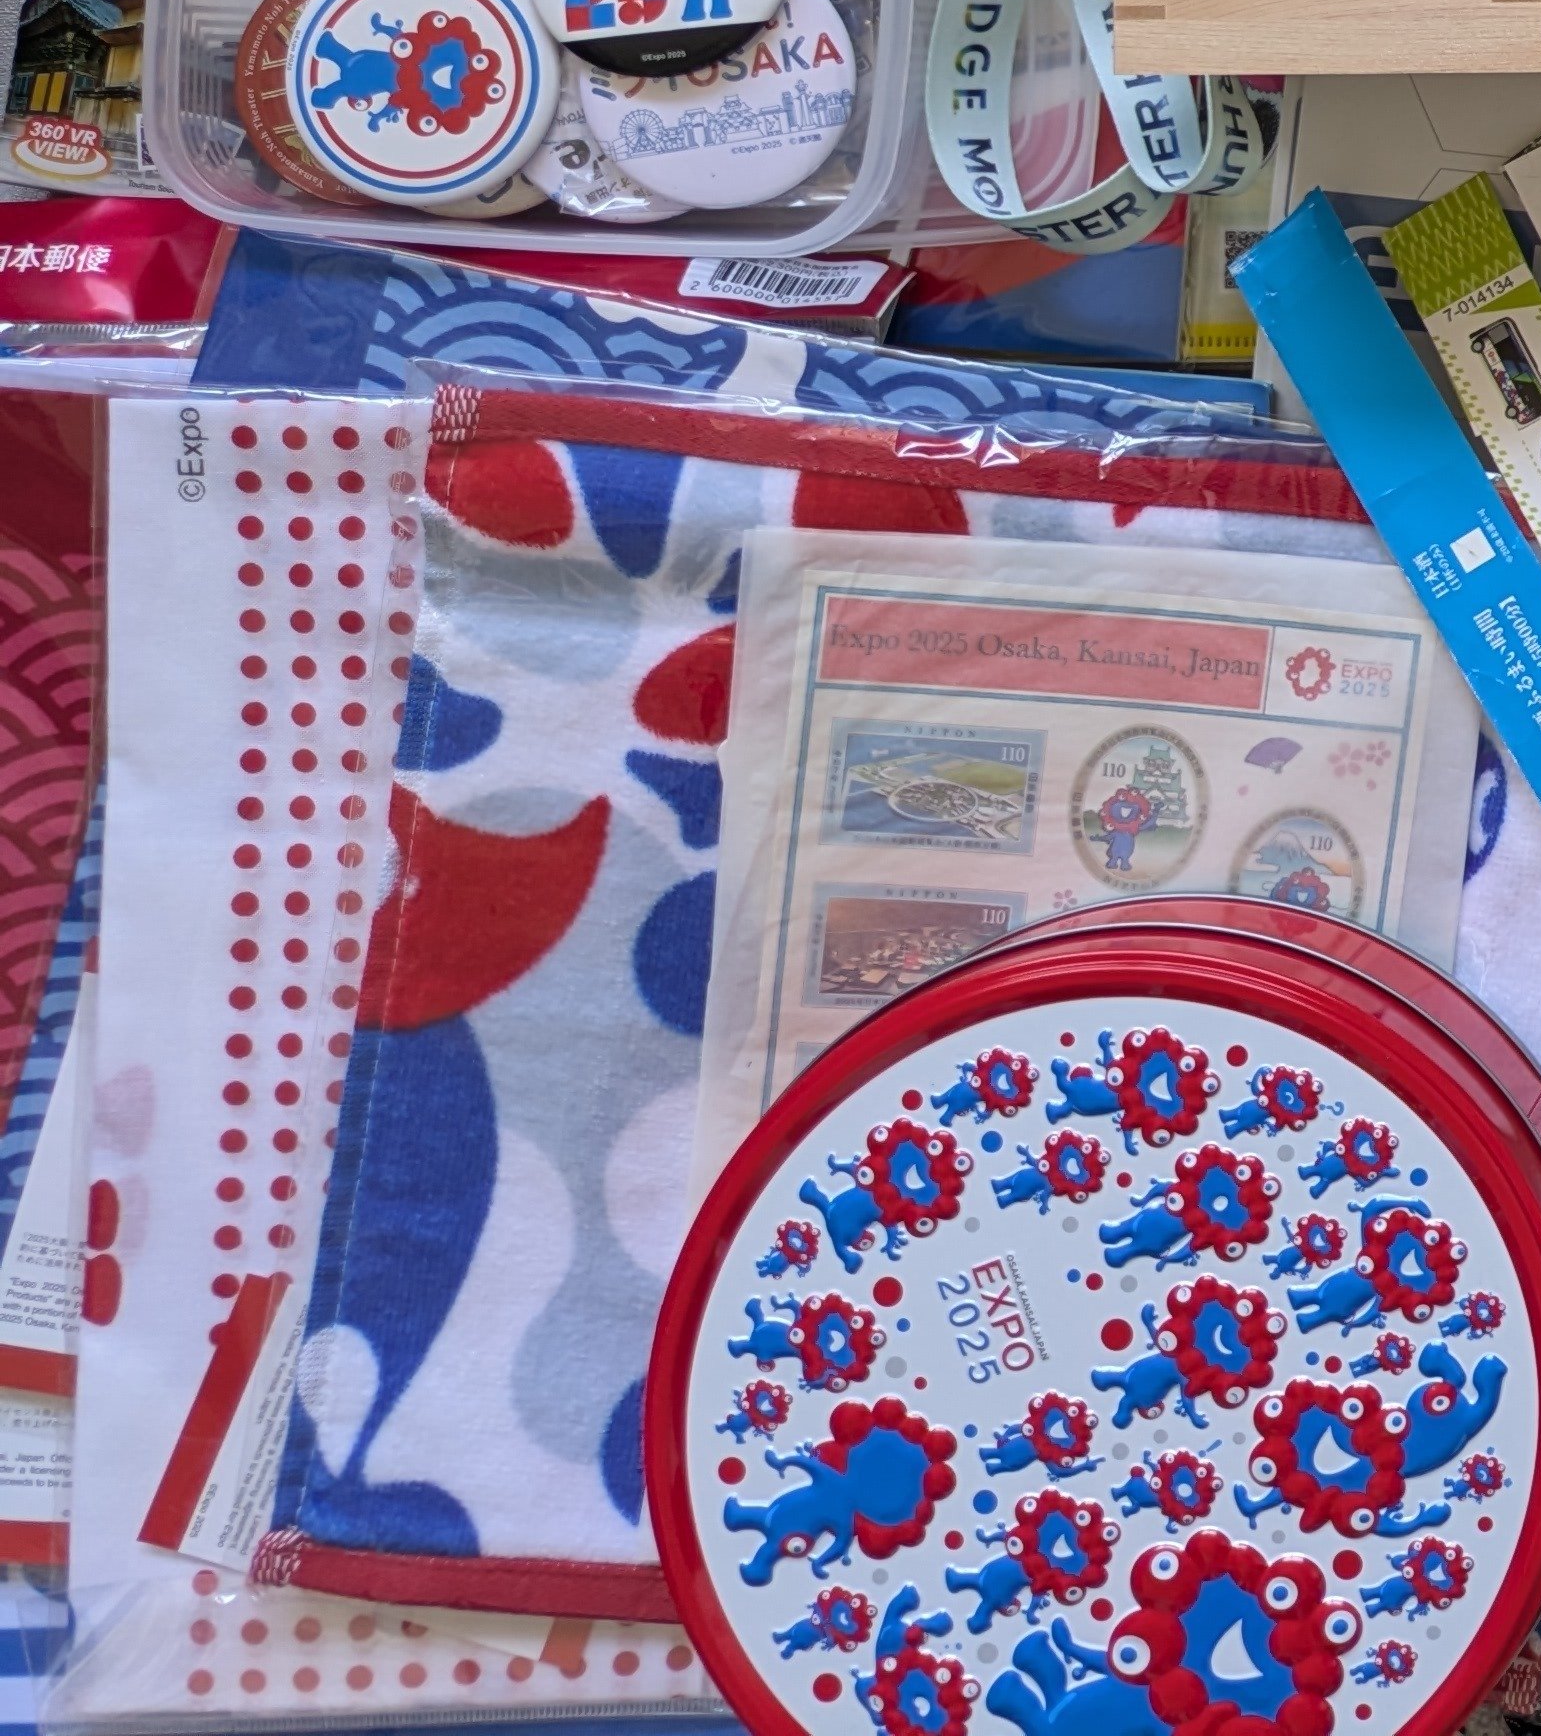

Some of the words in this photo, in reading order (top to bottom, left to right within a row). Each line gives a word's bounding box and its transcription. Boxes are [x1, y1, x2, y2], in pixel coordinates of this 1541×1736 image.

[33, 138, 91, 163] VIEW!
[1442, 275, 1515, 324] 7-014134
[177, 406, 206, 503] ©Expo
[828, 623, 899, 654] Expo
[906, 629, 969, 656] 2025
[976, 635, 1070, 665] Osaka,
[1075, 642, 1176, 675] Kansai,
[1180, 648, 1261, 681] Japan
[1339, 680, 1392, 699] 2025
[1341, 663, 1394, 682] EXPO
[999, 745, 1026, 763] 110
[1308, 834, 1335, 852] 110
[937, 1273, 1002, 1384] 2025
[971, 1258, 1036, 1372] EXPO
